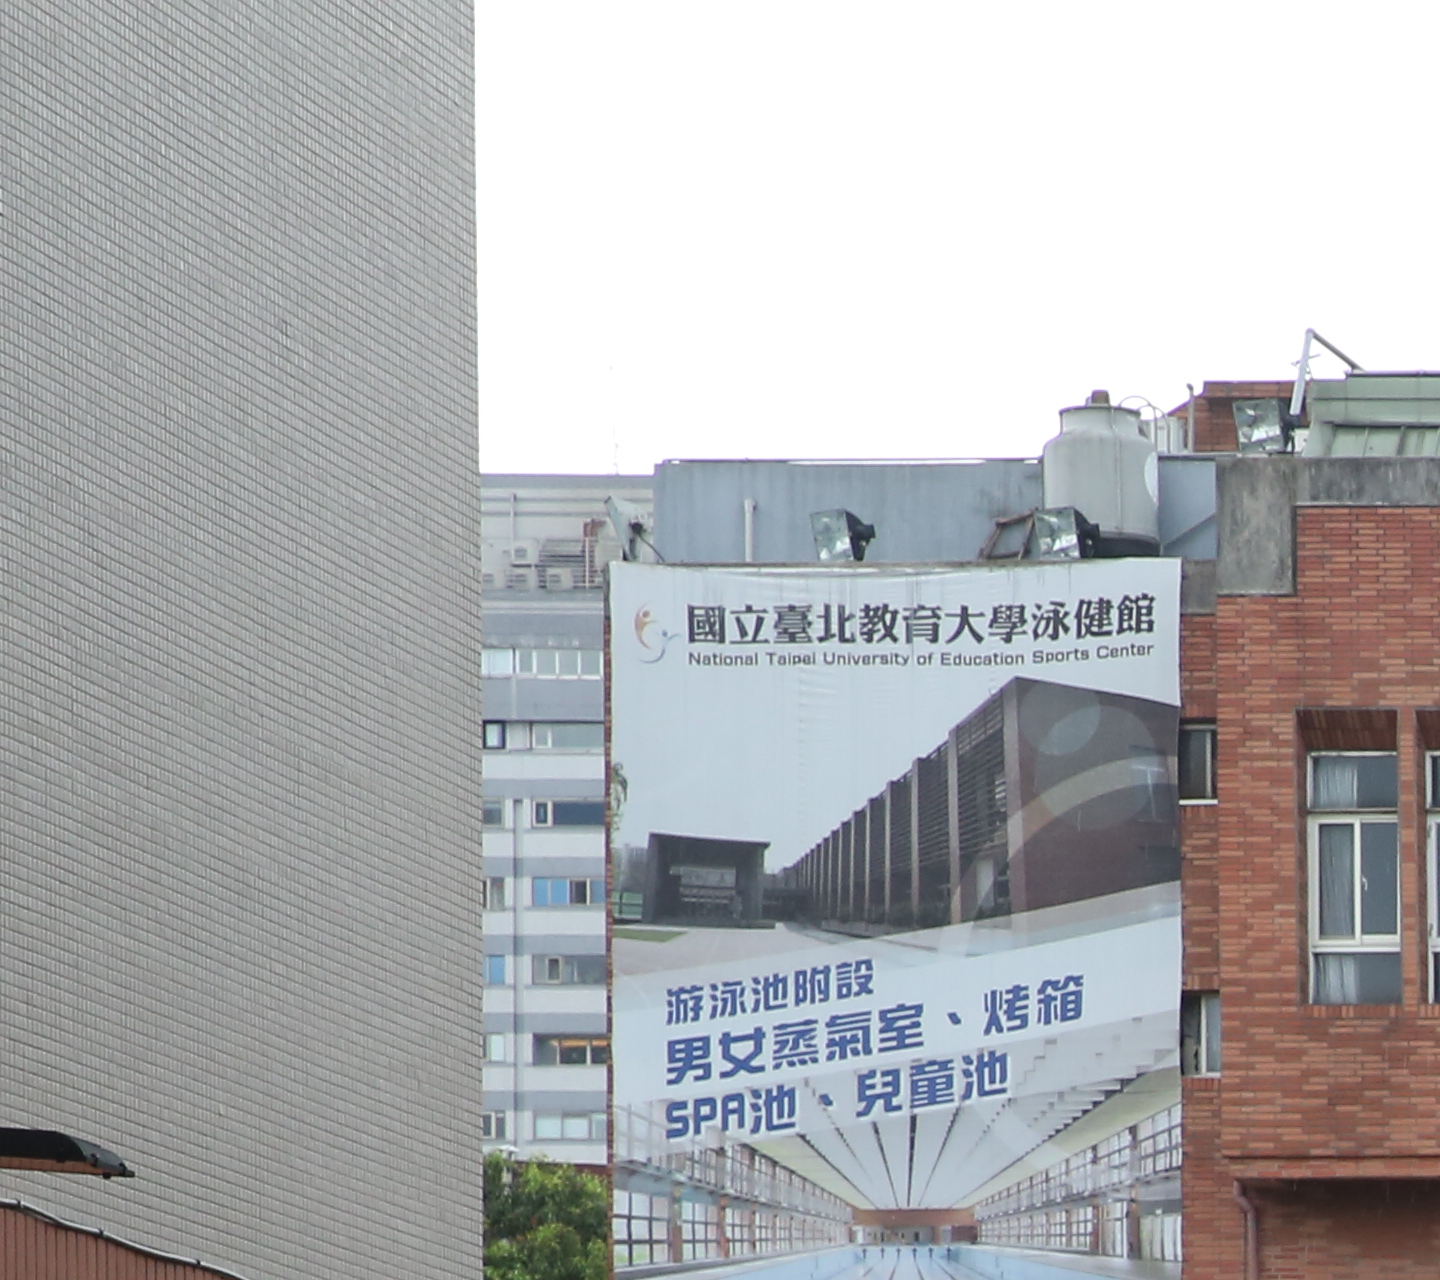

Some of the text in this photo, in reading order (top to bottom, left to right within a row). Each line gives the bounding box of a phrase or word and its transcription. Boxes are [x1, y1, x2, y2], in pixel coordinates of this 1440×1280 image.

[686, 593, 1156, 645] 國立臺北教育大學泳健館
[688, 642, 1154, 668] National Taipei University of Education Sports Center
[666, 958, 875, 1026] 游泳池附設
[666, 974, 1085, 1086] 男女蒸氣室、烤箱
[666, 1051, 1010, 1139] SPA池、兒童池
